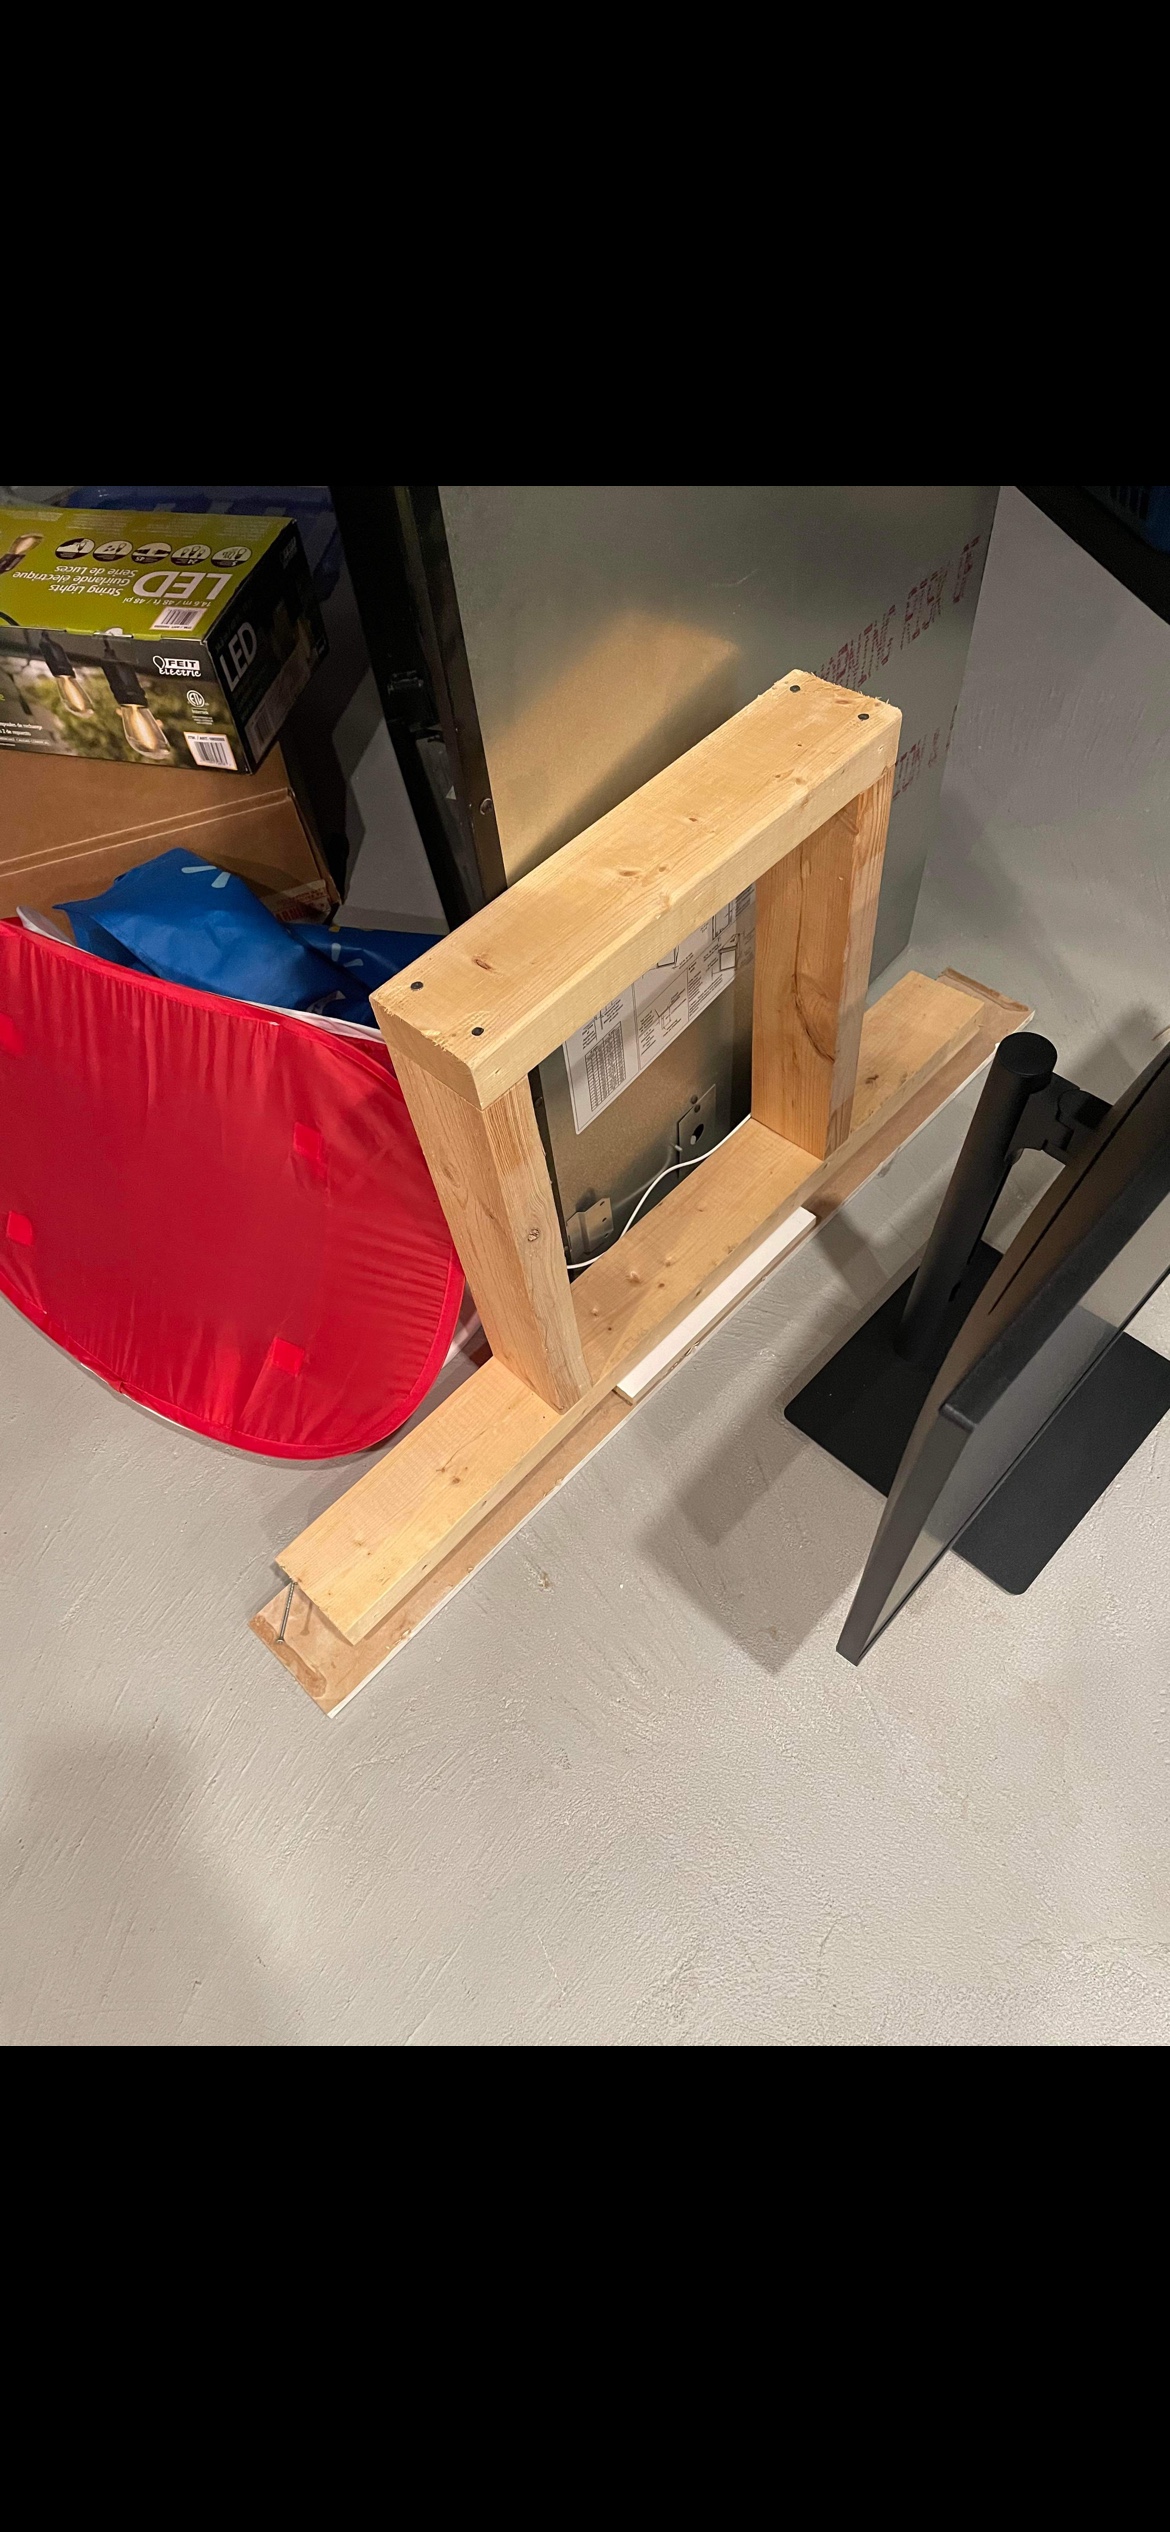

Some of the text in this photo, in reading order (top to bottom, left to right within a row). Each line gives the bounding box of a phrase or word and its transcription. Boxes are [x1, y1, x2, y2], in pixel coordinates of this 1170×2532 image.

[12, 570, 131, 587] Guirlande électrique
[54, 565, 139, 578] Serie de Luces
[48, 583, 124, 597] String Lights
[132, 570, 234, 600] LED
[134, 597, 146, 605] 48
[152, 598, 163, 606] ft
[814, 604, 896, 688] ARNING
[219, 621, 258, 693] LED
[168, 660, 197, 669] FEIT
